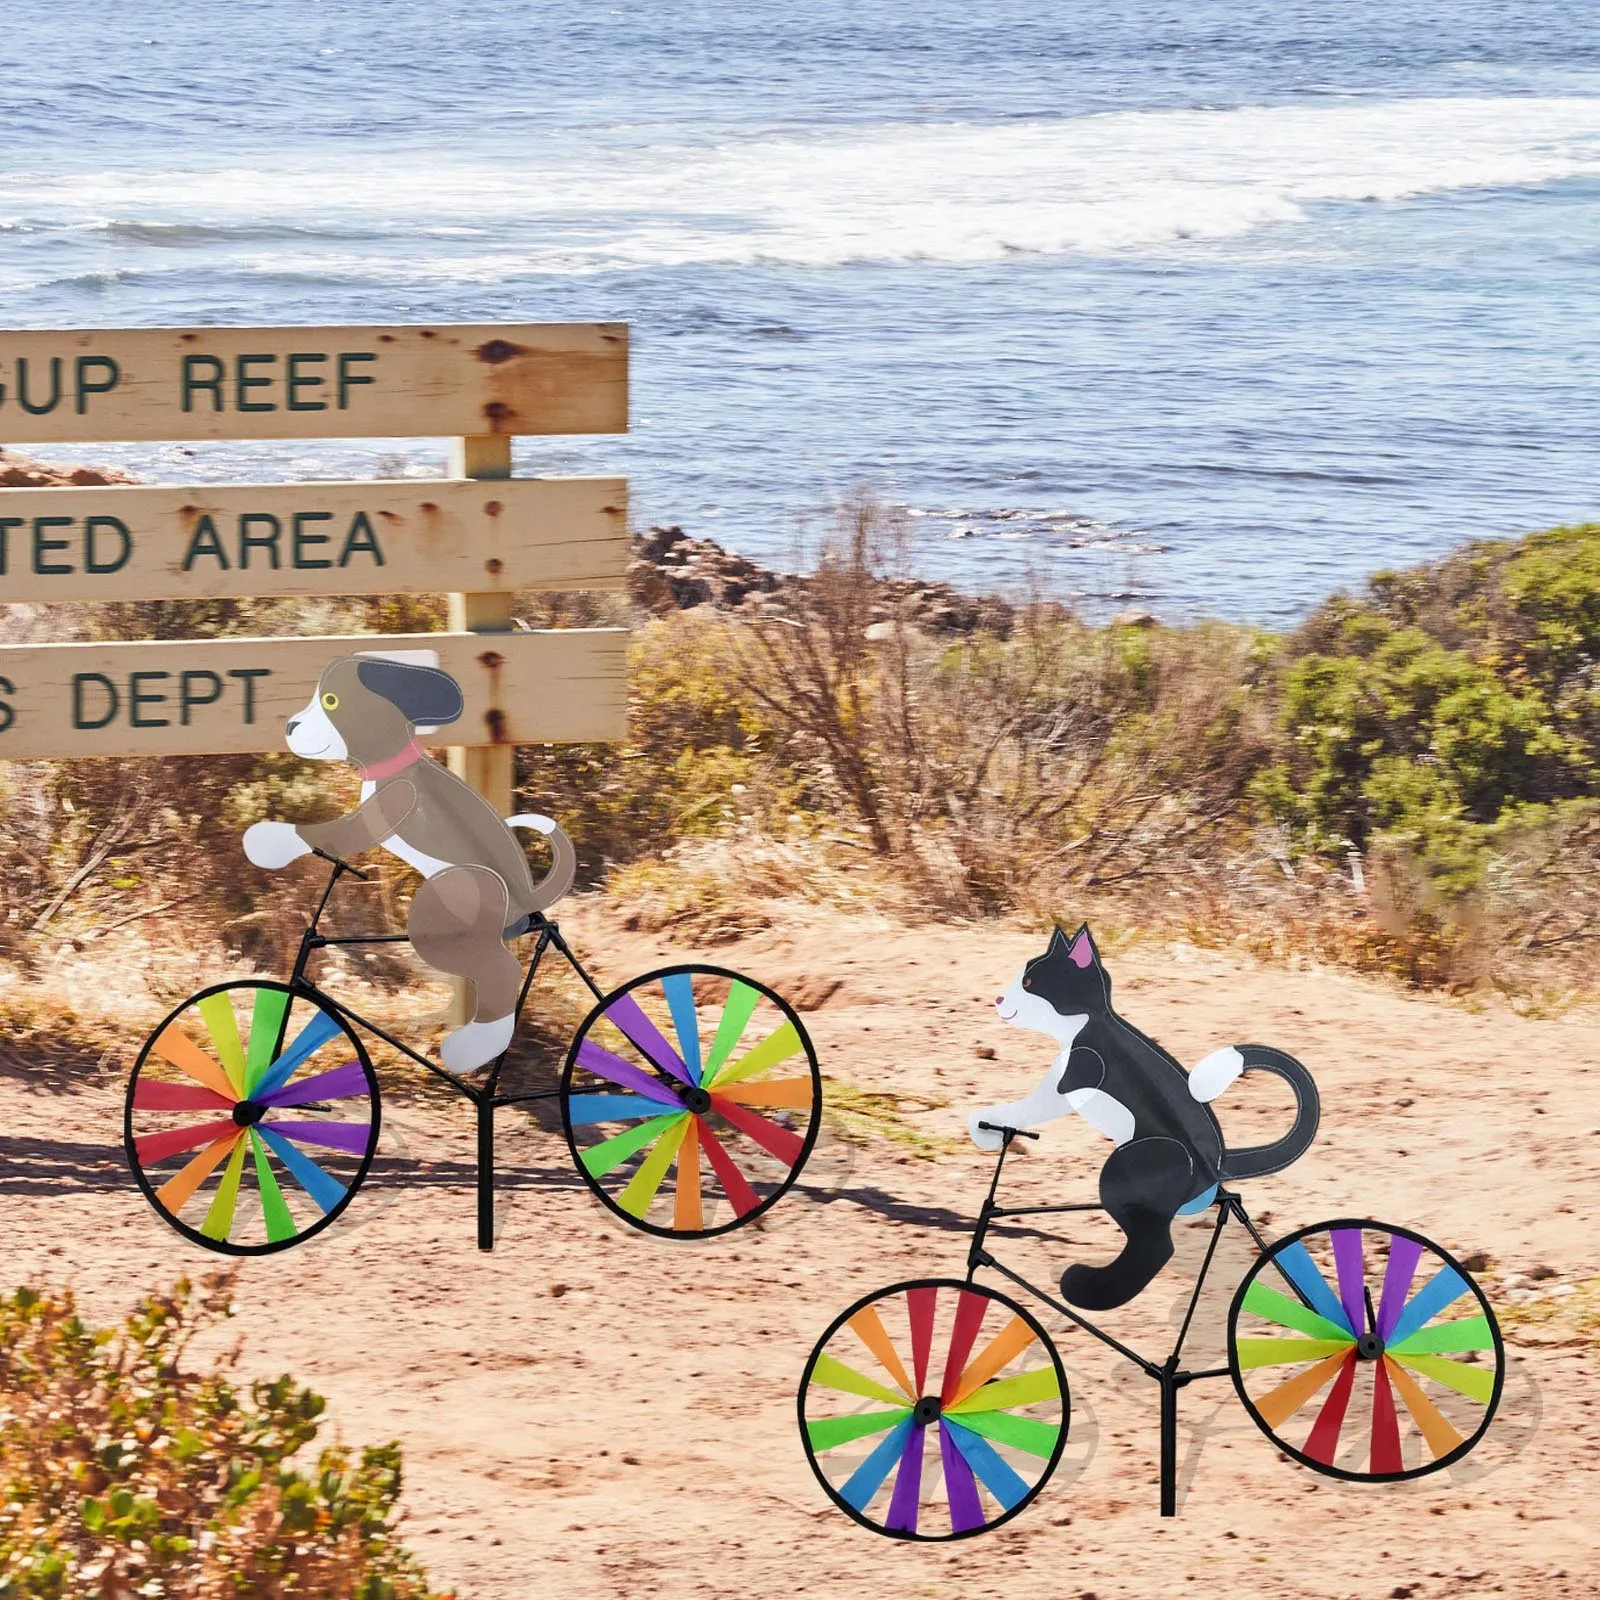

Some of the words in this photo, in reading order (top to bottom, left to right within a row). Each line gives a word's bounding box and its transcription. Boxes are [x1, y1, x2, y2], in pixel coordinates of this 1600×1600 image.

[0, 355, 121, 415] UP
[180, 352, 377, 413] REEF
[0, 515, 133, 575] TED
[181, 511, 386, 571] AREA
[72, 668, 271, 730] DEPT
